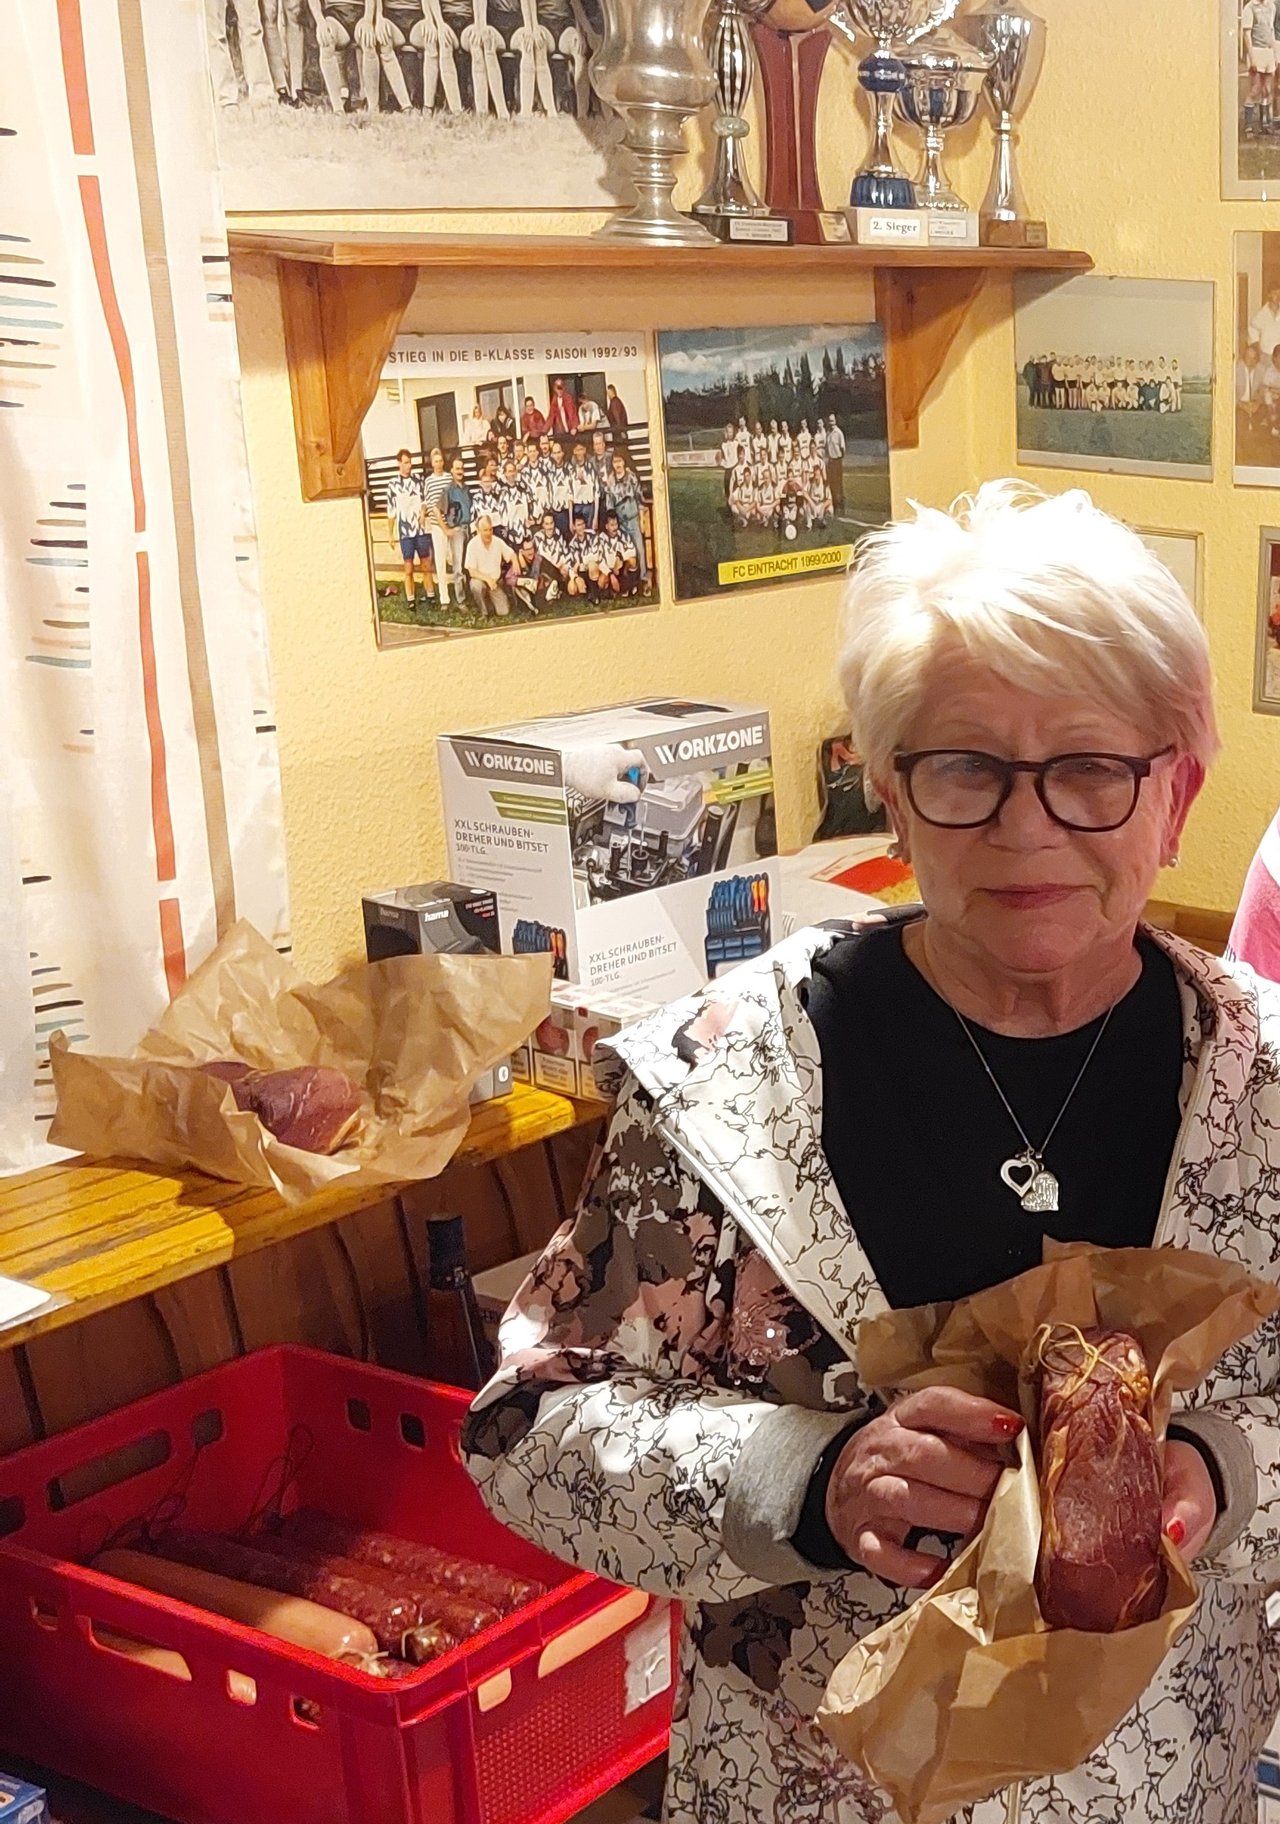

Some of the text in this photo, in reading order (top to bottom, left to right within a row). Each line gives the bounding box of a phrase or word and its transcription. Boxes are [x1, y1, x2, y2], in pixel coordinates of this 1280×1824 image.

[873, 221, 883, 230] 2.
[886, 221, 918, 235] Sieger
[388, 346, 638, 363] STIEG IN DIE B-KLASSE SAISON 1992/93
[732, 566, 746, 578] FC
[748, 558, 798, 576] EINTRACHT
[654, 725, 764, 765] WORKZONE
[464, 750, 555, 776] WORKZONE
[454, 819, 534, 838] XXL SCHRAUBEN-
[456, 832, 549, 853] DREHER UND BITSET
[424, 909, 450, 923] hama
[589, 934, 665, 964] XXL SCHRAUBEN-
[590, 941, 677, 976] DREHER UND BITSET
